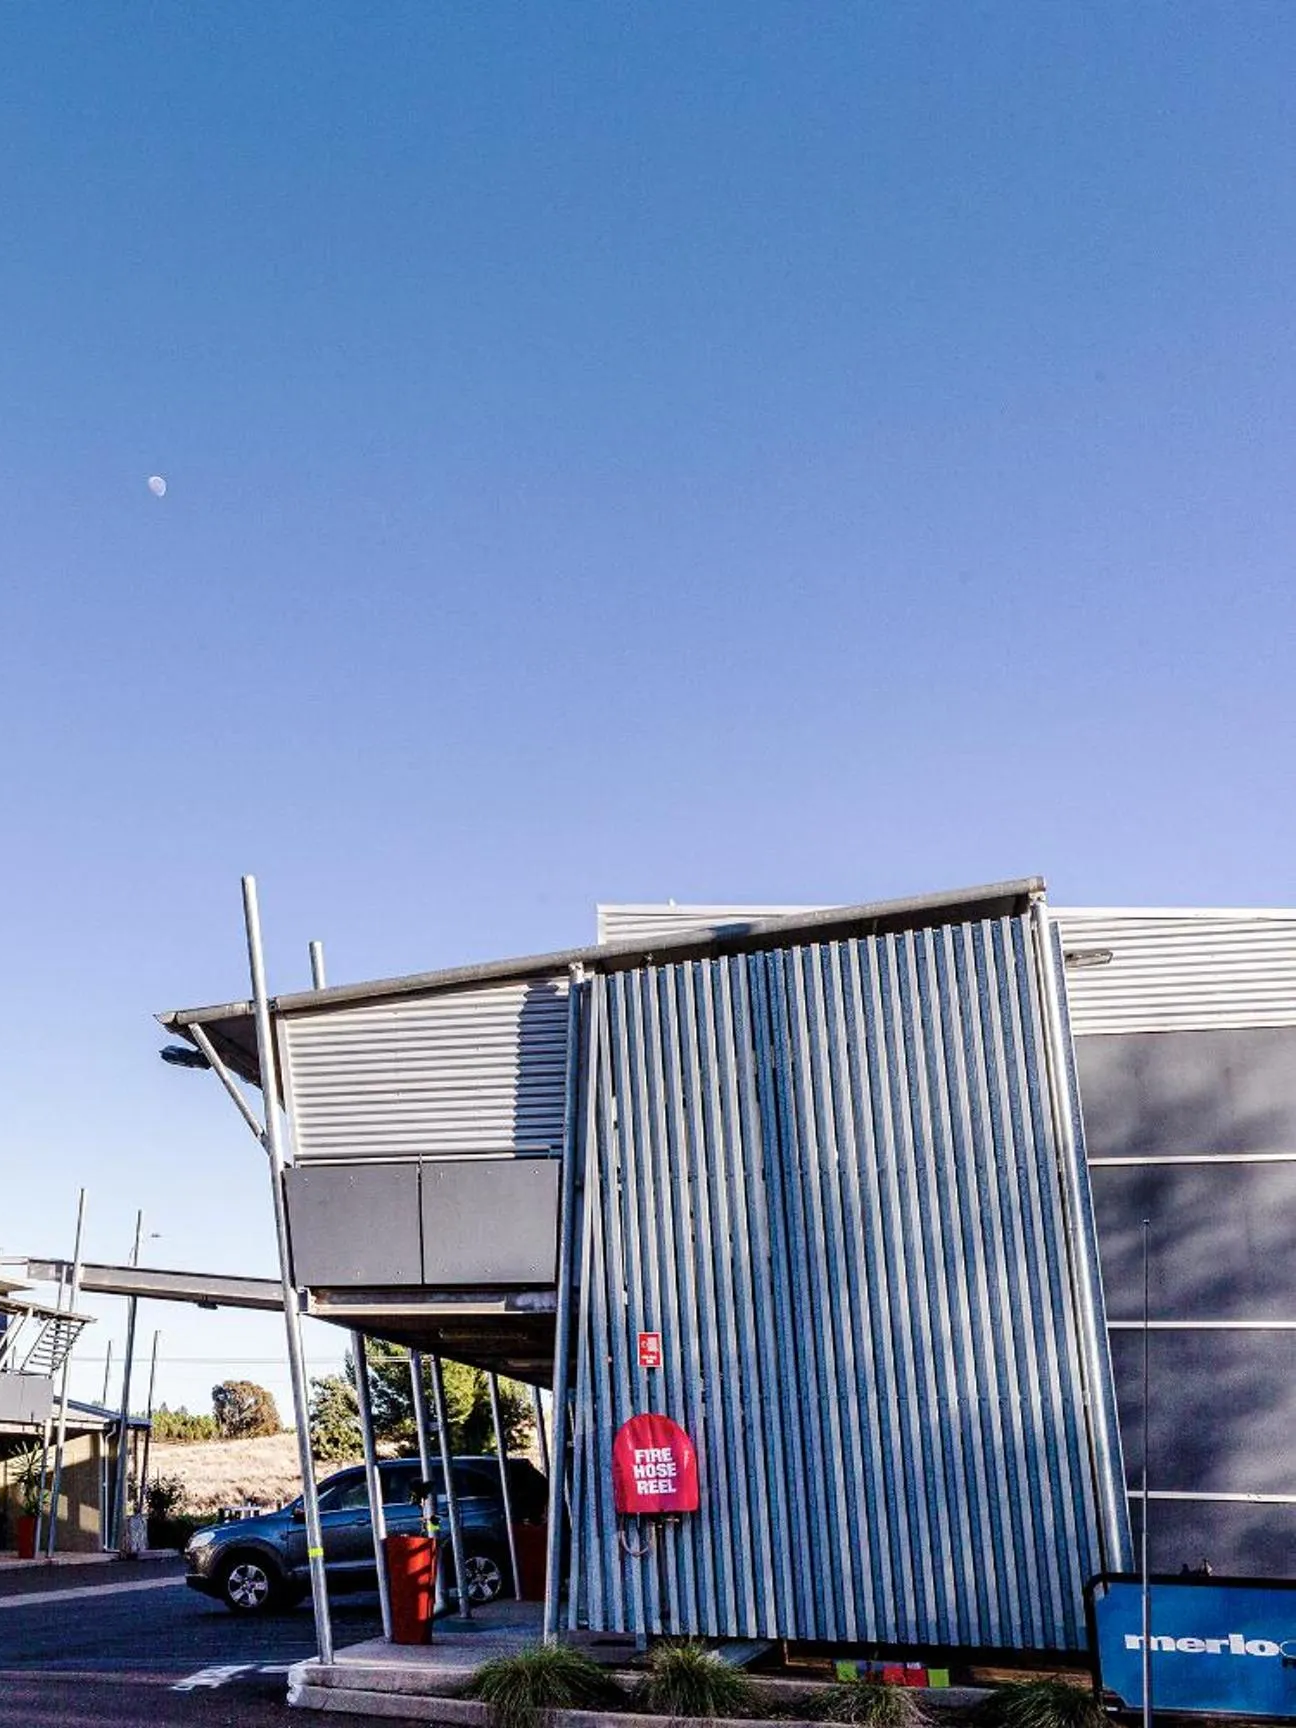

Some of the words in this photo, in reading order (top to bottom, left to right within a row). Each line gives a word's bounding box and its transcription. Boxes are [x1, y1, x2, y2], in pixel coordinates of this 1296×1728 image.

[634, 1447, 672, 1464] FIRE
[633, 1462, 676, 1479] HOSE
[637, 1479, 676, 1495] REEL
